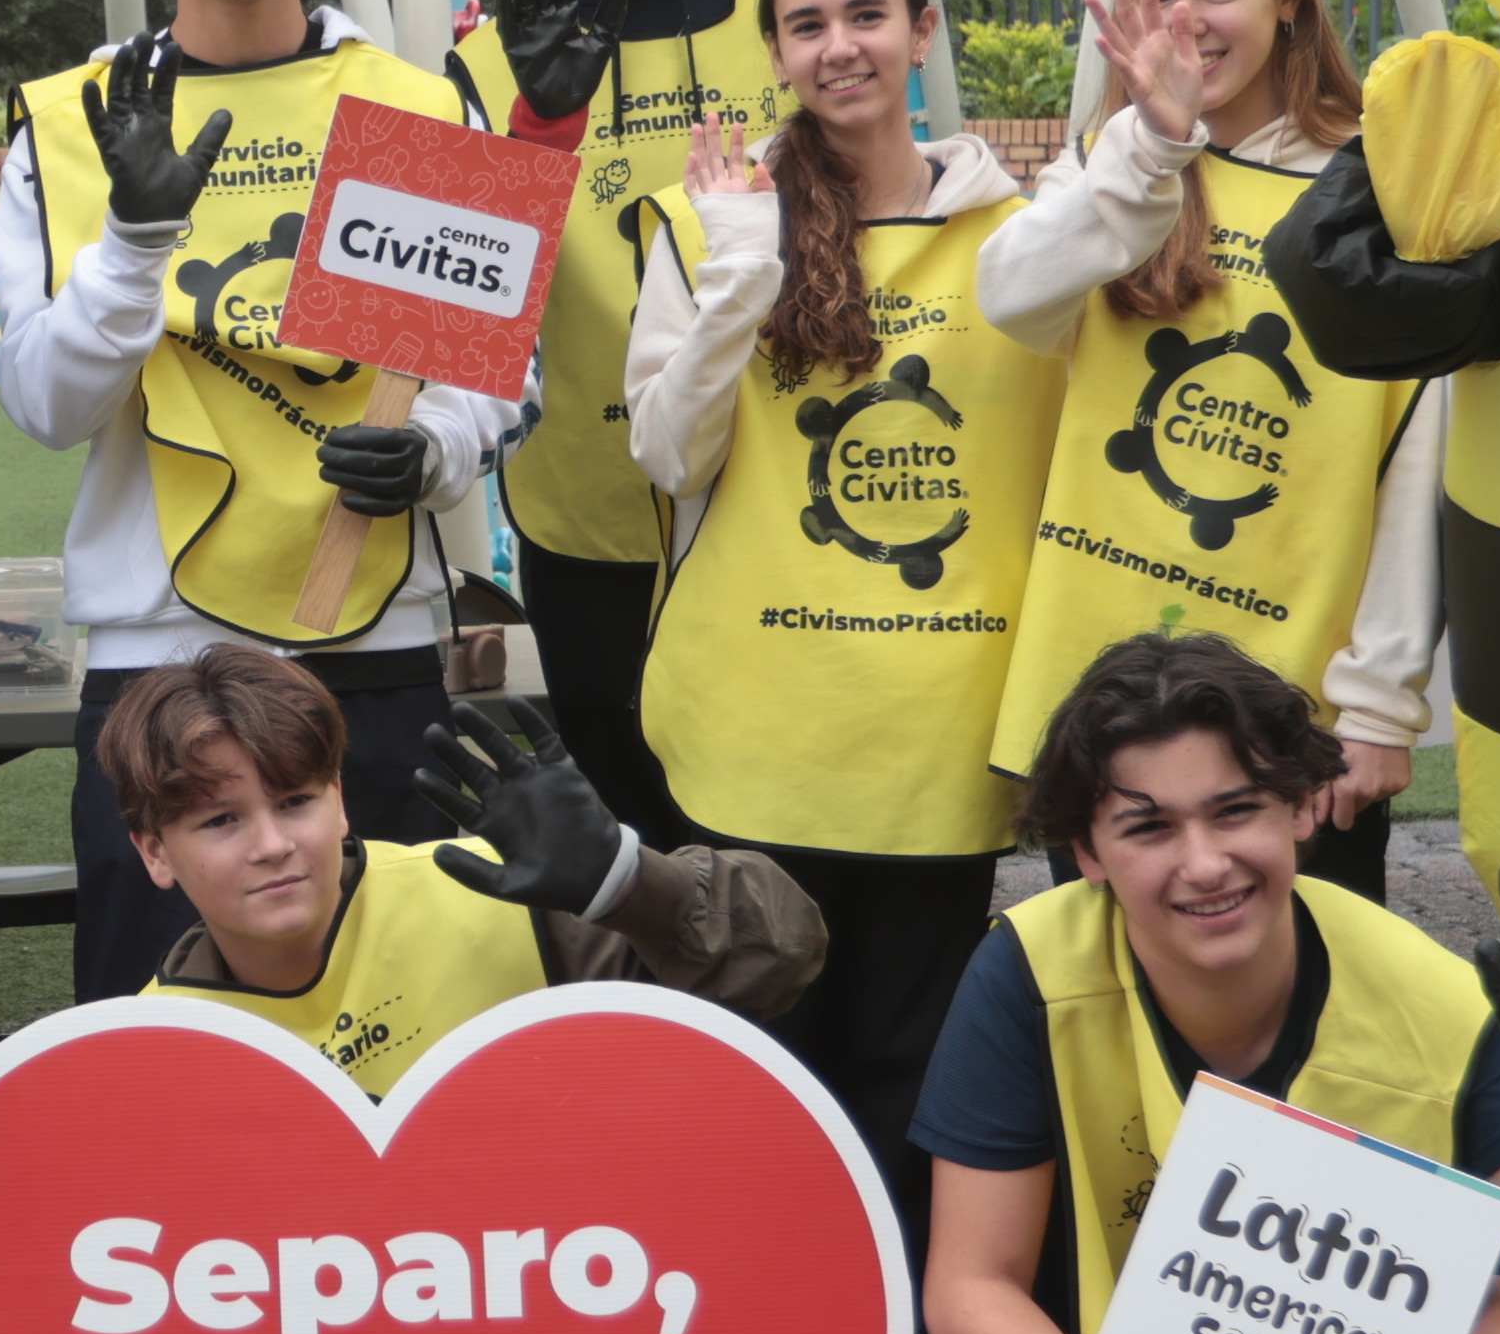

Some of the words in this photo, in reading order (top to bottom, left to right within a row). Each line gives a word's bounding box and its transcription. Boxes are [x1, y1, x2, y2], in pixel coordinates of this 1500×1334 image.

[438, 226, 510, 255] centro
[1175, 381, 1290, 441] Centro
[839, 439, 956, 469] Centro
[1037, 520, 1290, 623] #CivismoPráctico
[759, 606, 1008, 634] #CivismoPráctico
[1198, 1168, 1430, 1314] Latin
